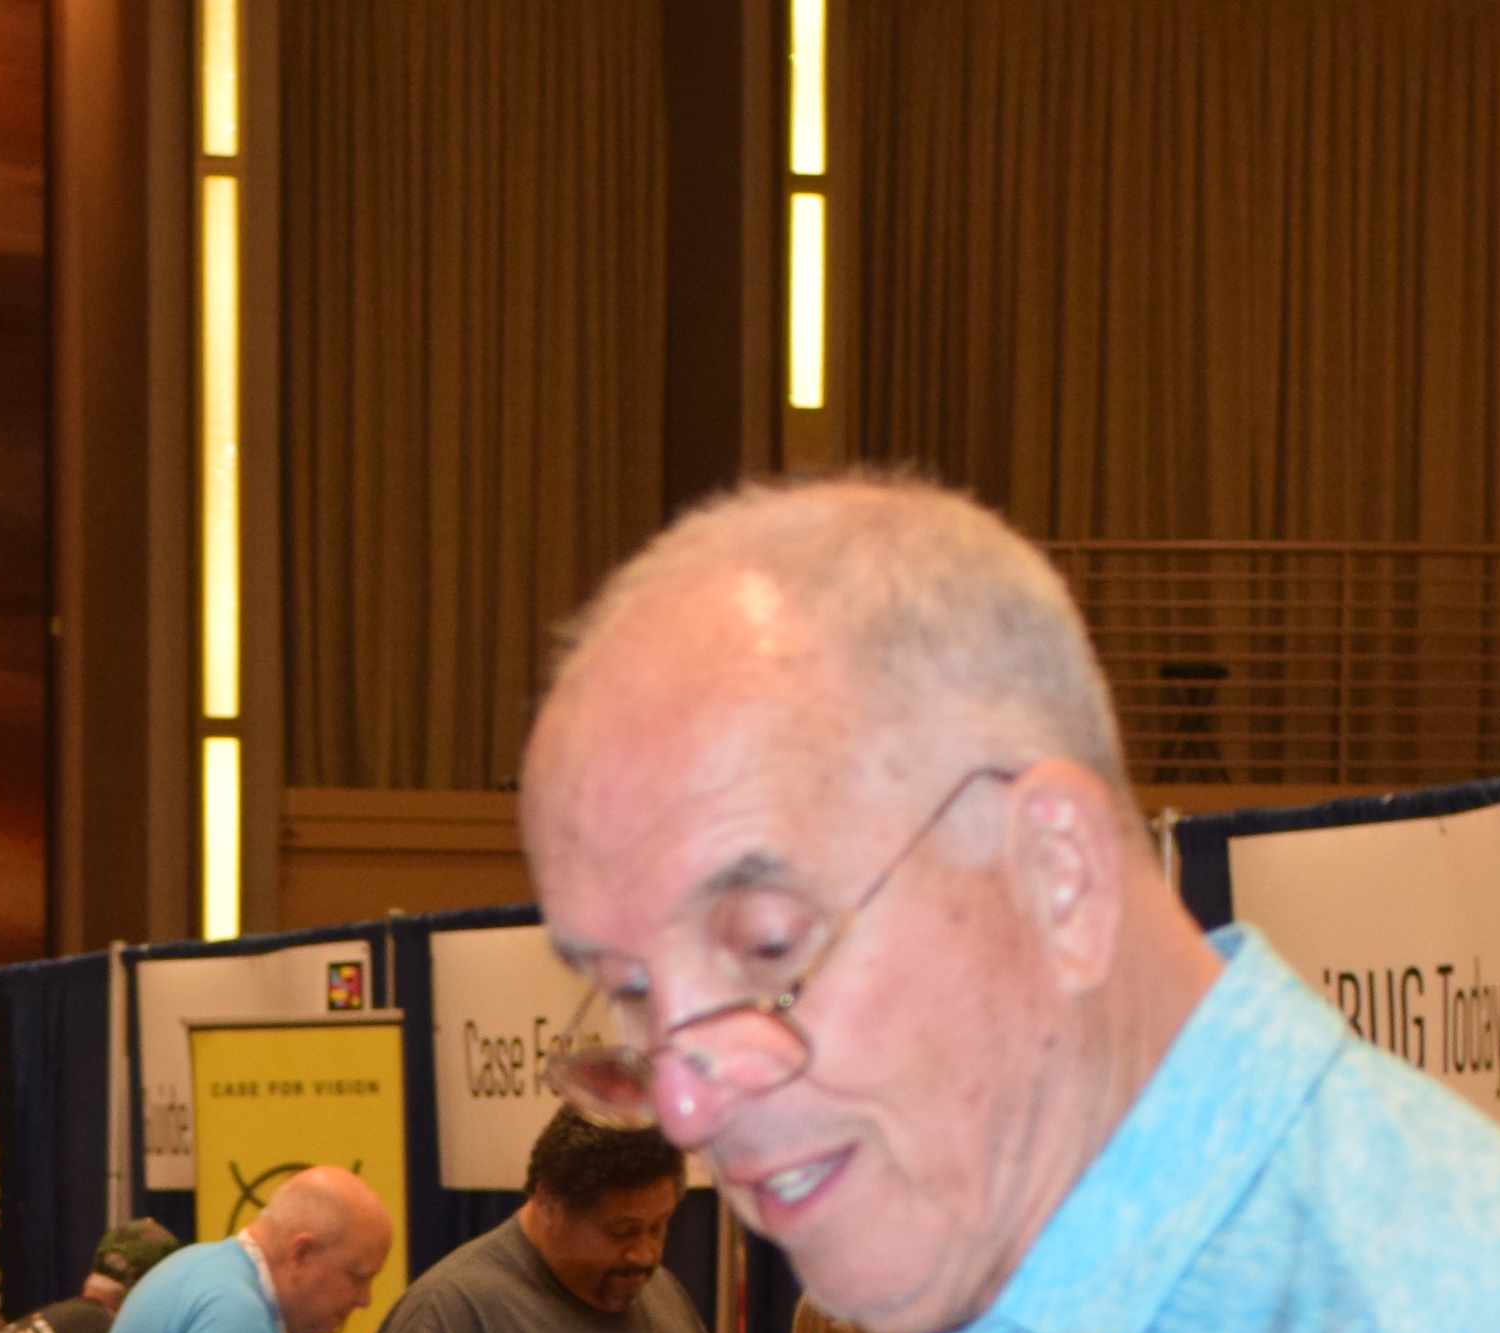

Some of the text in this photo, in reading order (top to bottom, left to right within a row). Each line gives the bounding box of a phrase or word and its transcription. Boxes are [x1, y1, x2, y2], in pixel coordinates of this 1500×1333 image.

[465, 1019, 524, 1098] Case
[210, 1077, 380, 1099] CASE FOR VISION
